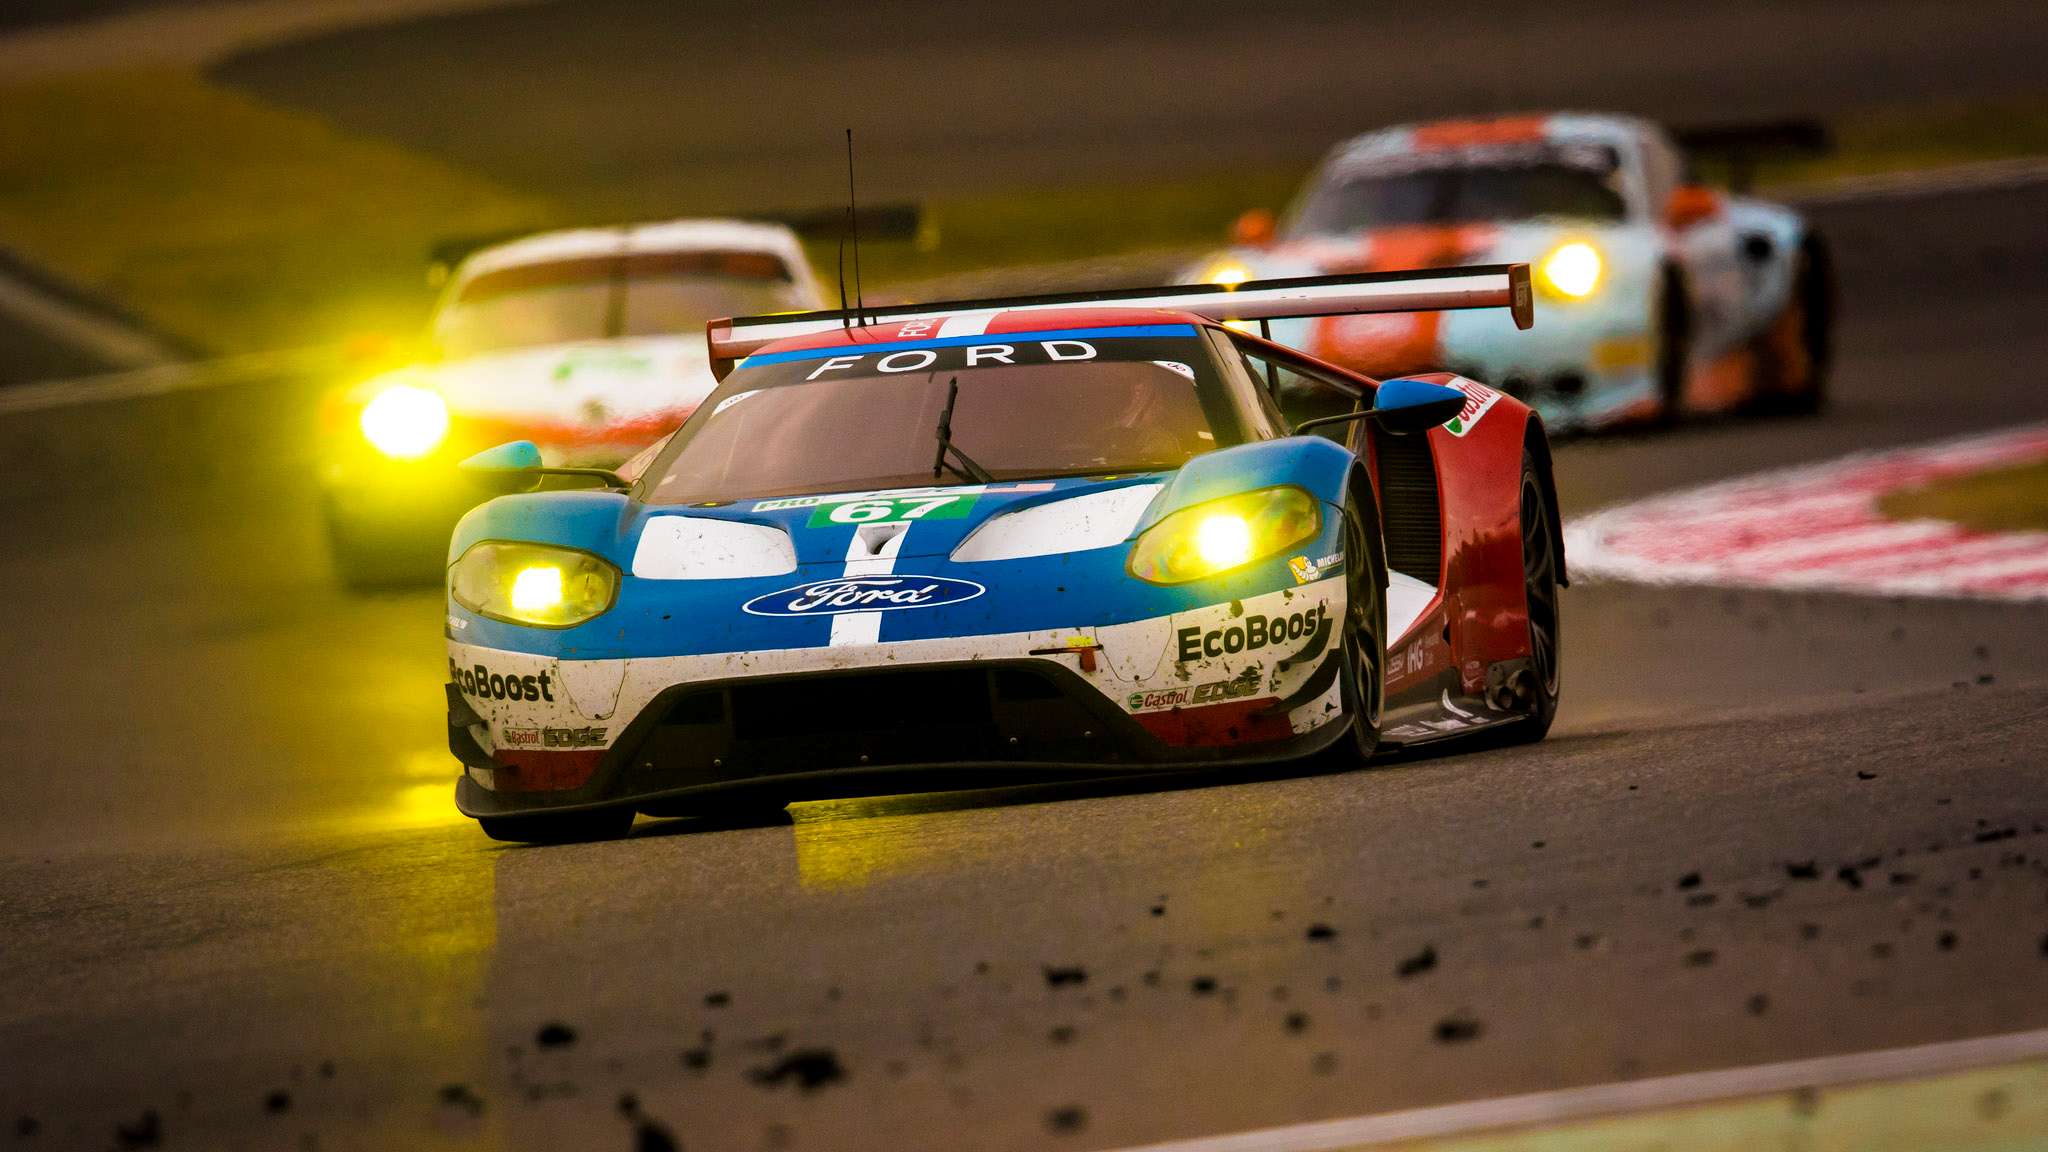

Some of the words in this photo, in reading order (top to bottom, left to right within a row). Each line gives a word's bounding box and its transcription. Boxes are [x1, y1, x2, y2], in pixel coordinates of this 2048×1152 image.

[897, 319, 938, 337] FOR
[805, 340, 1097, 382] FORD
[758, 497, 819, 511] PRO
[829, 496, 960, 523] 67
[788, 579, 939, 612] Ford
[1177, 600, 1327, 662] EcoBoost
[1144, 689, 1188, 708] Castrol
[1192, 677, 1261, 704] EDGE
[511, 730, 540, 746] Castrol
[544, 727, 608, 748] EDGE
